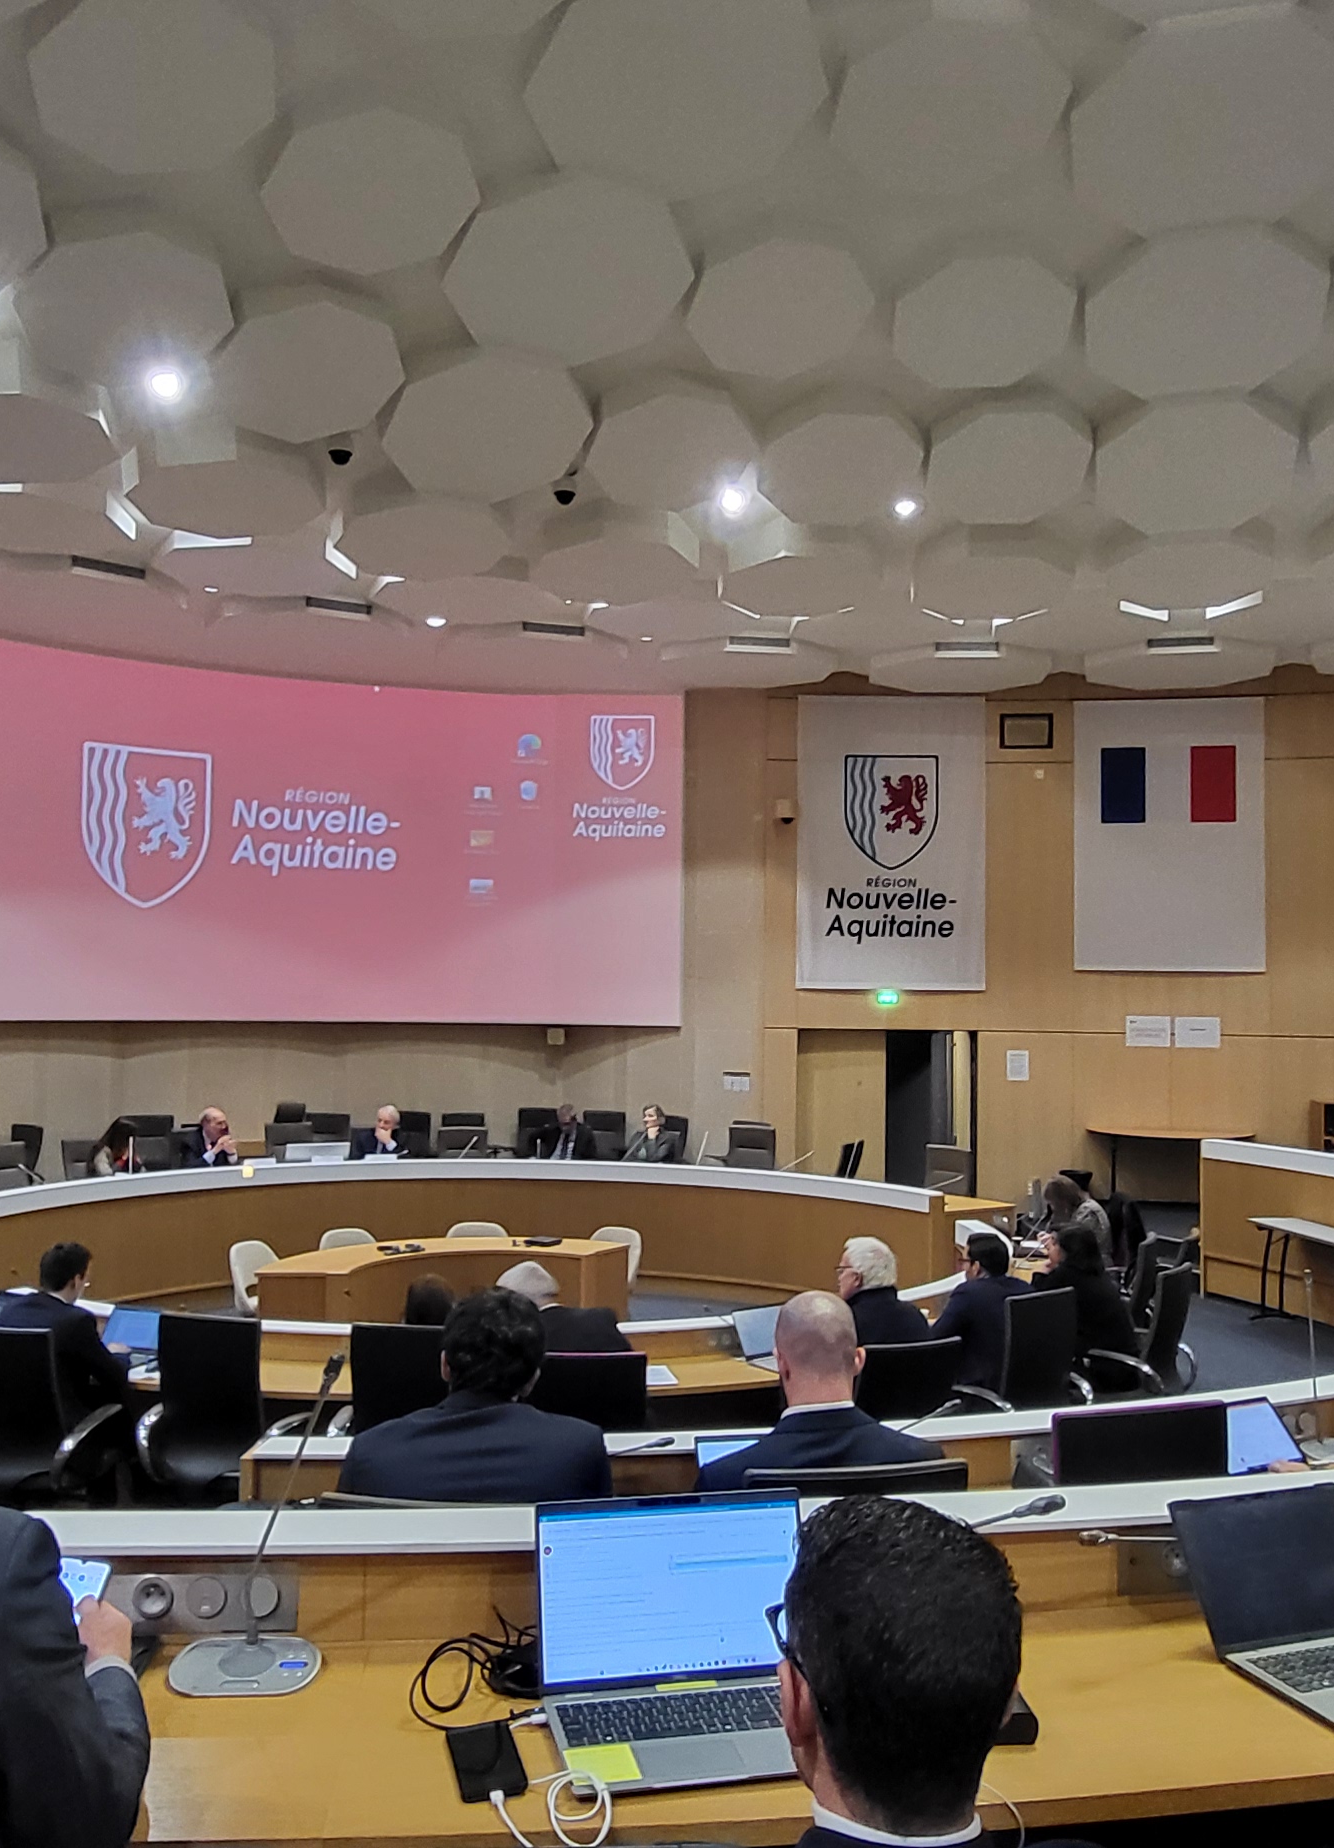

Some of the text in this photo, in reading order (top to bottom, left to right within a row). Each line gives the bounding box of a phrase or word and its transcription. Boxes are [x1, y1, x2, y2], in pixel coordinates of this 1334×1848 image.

[284, 786, 350, 805] RÉGION
[231, 798, 401, 835] Nouvelle-
[572, 802, 666, 819] Nouvelle-
[572, 820, 666, 842] Aquitaine
[230, 833, 397, 876] Aquitaine
[866, 876, 917, 888] RÉGION
[825, 887, 957, 910] Nouvelle-
[824, 913, 954, 945] Aquitaine
